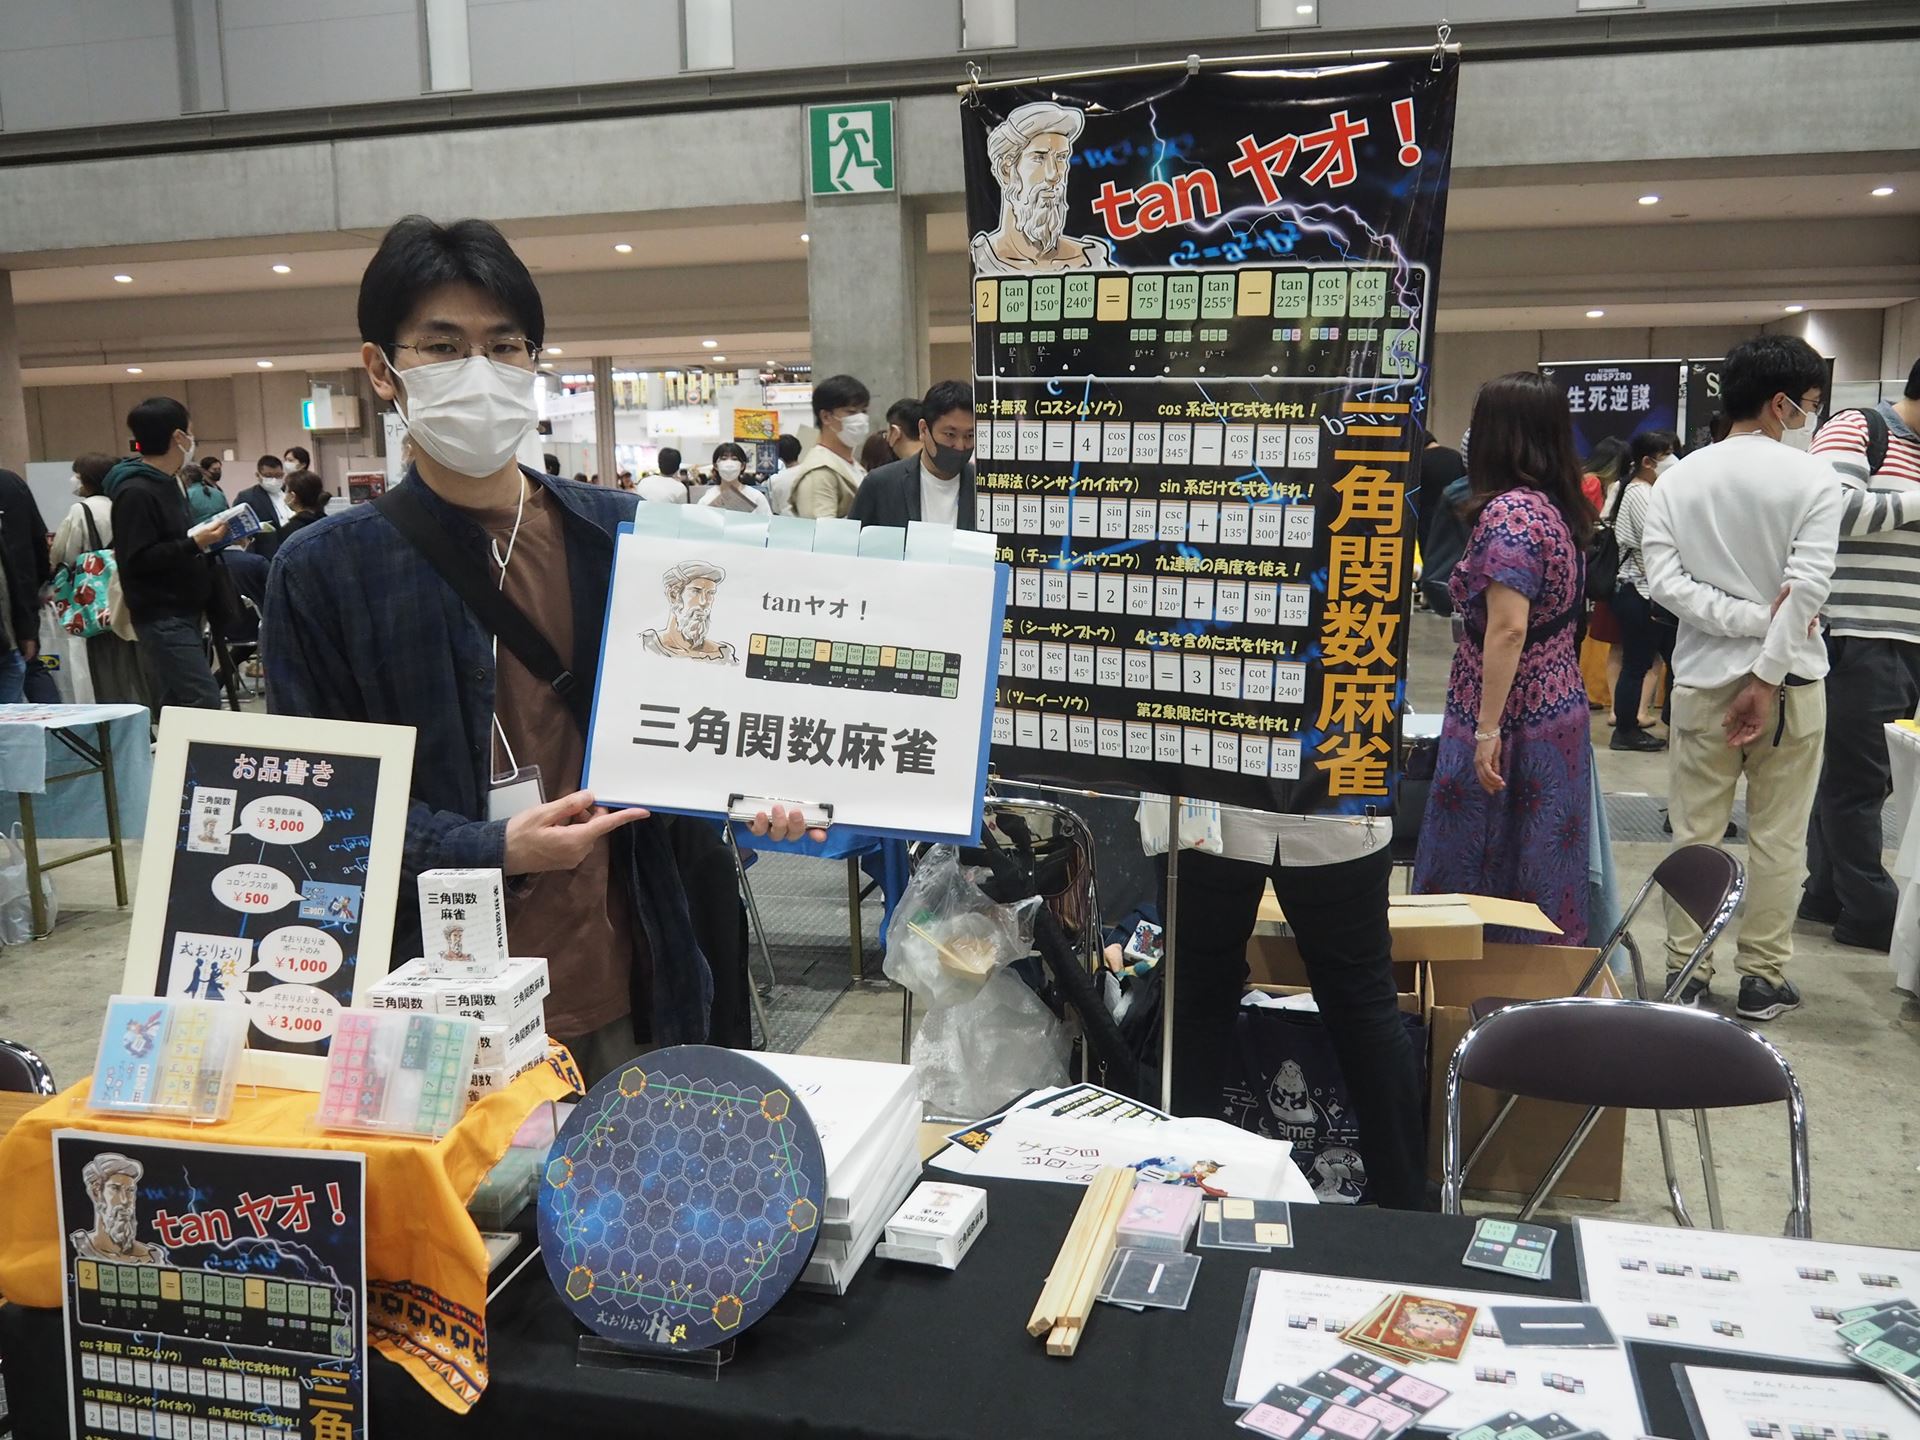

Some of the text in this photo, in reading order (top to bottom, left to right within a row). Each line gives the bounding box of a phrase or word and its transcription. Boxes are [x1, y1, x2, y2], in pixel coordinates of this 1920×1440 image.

[1091, 98, 1422, 240] tan ヤオ！
[983, 278, 1379, 307] 2 tan cot cot cot tan tan tan cot cot
[1007, 295, 1383, 312] 60° 150° 240° 75° 195° 255° 225° 135° 345°
[976, 403, 987, 413] cos
[1567, 384, 1650, 413] 生死逆謀
[1158, 402, 1317, 418] cos 系だけで式を作れ！
[1025, 445, 1315, 460] 15° 120° 345° 45° 135° 165°
[1082, 439, 1090, 451] 4
[1108, 432, 1125, 440] cos
[1263, 435, 1280, 443] sec
[1295, 436, 1313, 444] cos
[1160, 479, 1180, 493] sin
[980, 503, 1309, 524] 2 sin sin sin sin sin csc sin sin csc
[996, 518, 1013, 526] 150°
[1024, 519, 1037, 528] 75°
[1050, 520, 1064, 528] 90°
[1107, 523, 1121, 532] 15°
[1225, 528, 1246, 536] 135°
[1288, 531, 1311, 540] 240°
[1021, 578, 1303, 603] sec sin 2 sin sin tan sin tan
[1314, 403, 1410, 797] 三角関数麻雀
[1022, 592, 1036, 600] 75°
[1046, 594, 1065, 602] 105°
[1132, 600, 1147, 609] 60°
[1159, 602, 1180, 610] 120°
[1222, 607, 1238, 615] 45°
[1284, 610, 1307, 619] 135°
[1020, 649, 1300, 683] cot sec tan csc cos 3 sec cot tan
[1022, 664, 1302, 696] 30° 45° 45° 135° 210° 15° 120° 240°
[632, 703, 938, 775] 三角関数麻雀
[1050, 729, 1057, 741] 2
[1075, 726, 1089, 734] sin
[1102, 728, 1118, 736] cos
[1131, 731, 1147, 739] sec
[1160, 732, 1175, 741] sin
[1217, 741, 1234, 750] cos
[1246, 744, 1262, 754] cot
[1278, 748, 1295, 757] tan
[993, 730, 1297, 772] 135° 105° 105° 120° 150° 150° 165° 135°
[232, 754, 334, 786] お品書き
[197, 795, 231, 805] 三角関数
[204, 807, 221, 815] 麻雀
[427, 893, 478, 905] 三角関数
[441, 909, 465, 920] 麻雀
[179, 941, 243, 960] 式おりおり
[445, 995, 496, 1007] 三角関数
[513, 975, 545, 1008] 三角関数麻雀
[373, 997, 423, 1009] 三角関数
[152, 1182, 347, 1250] tan ヤオ！
